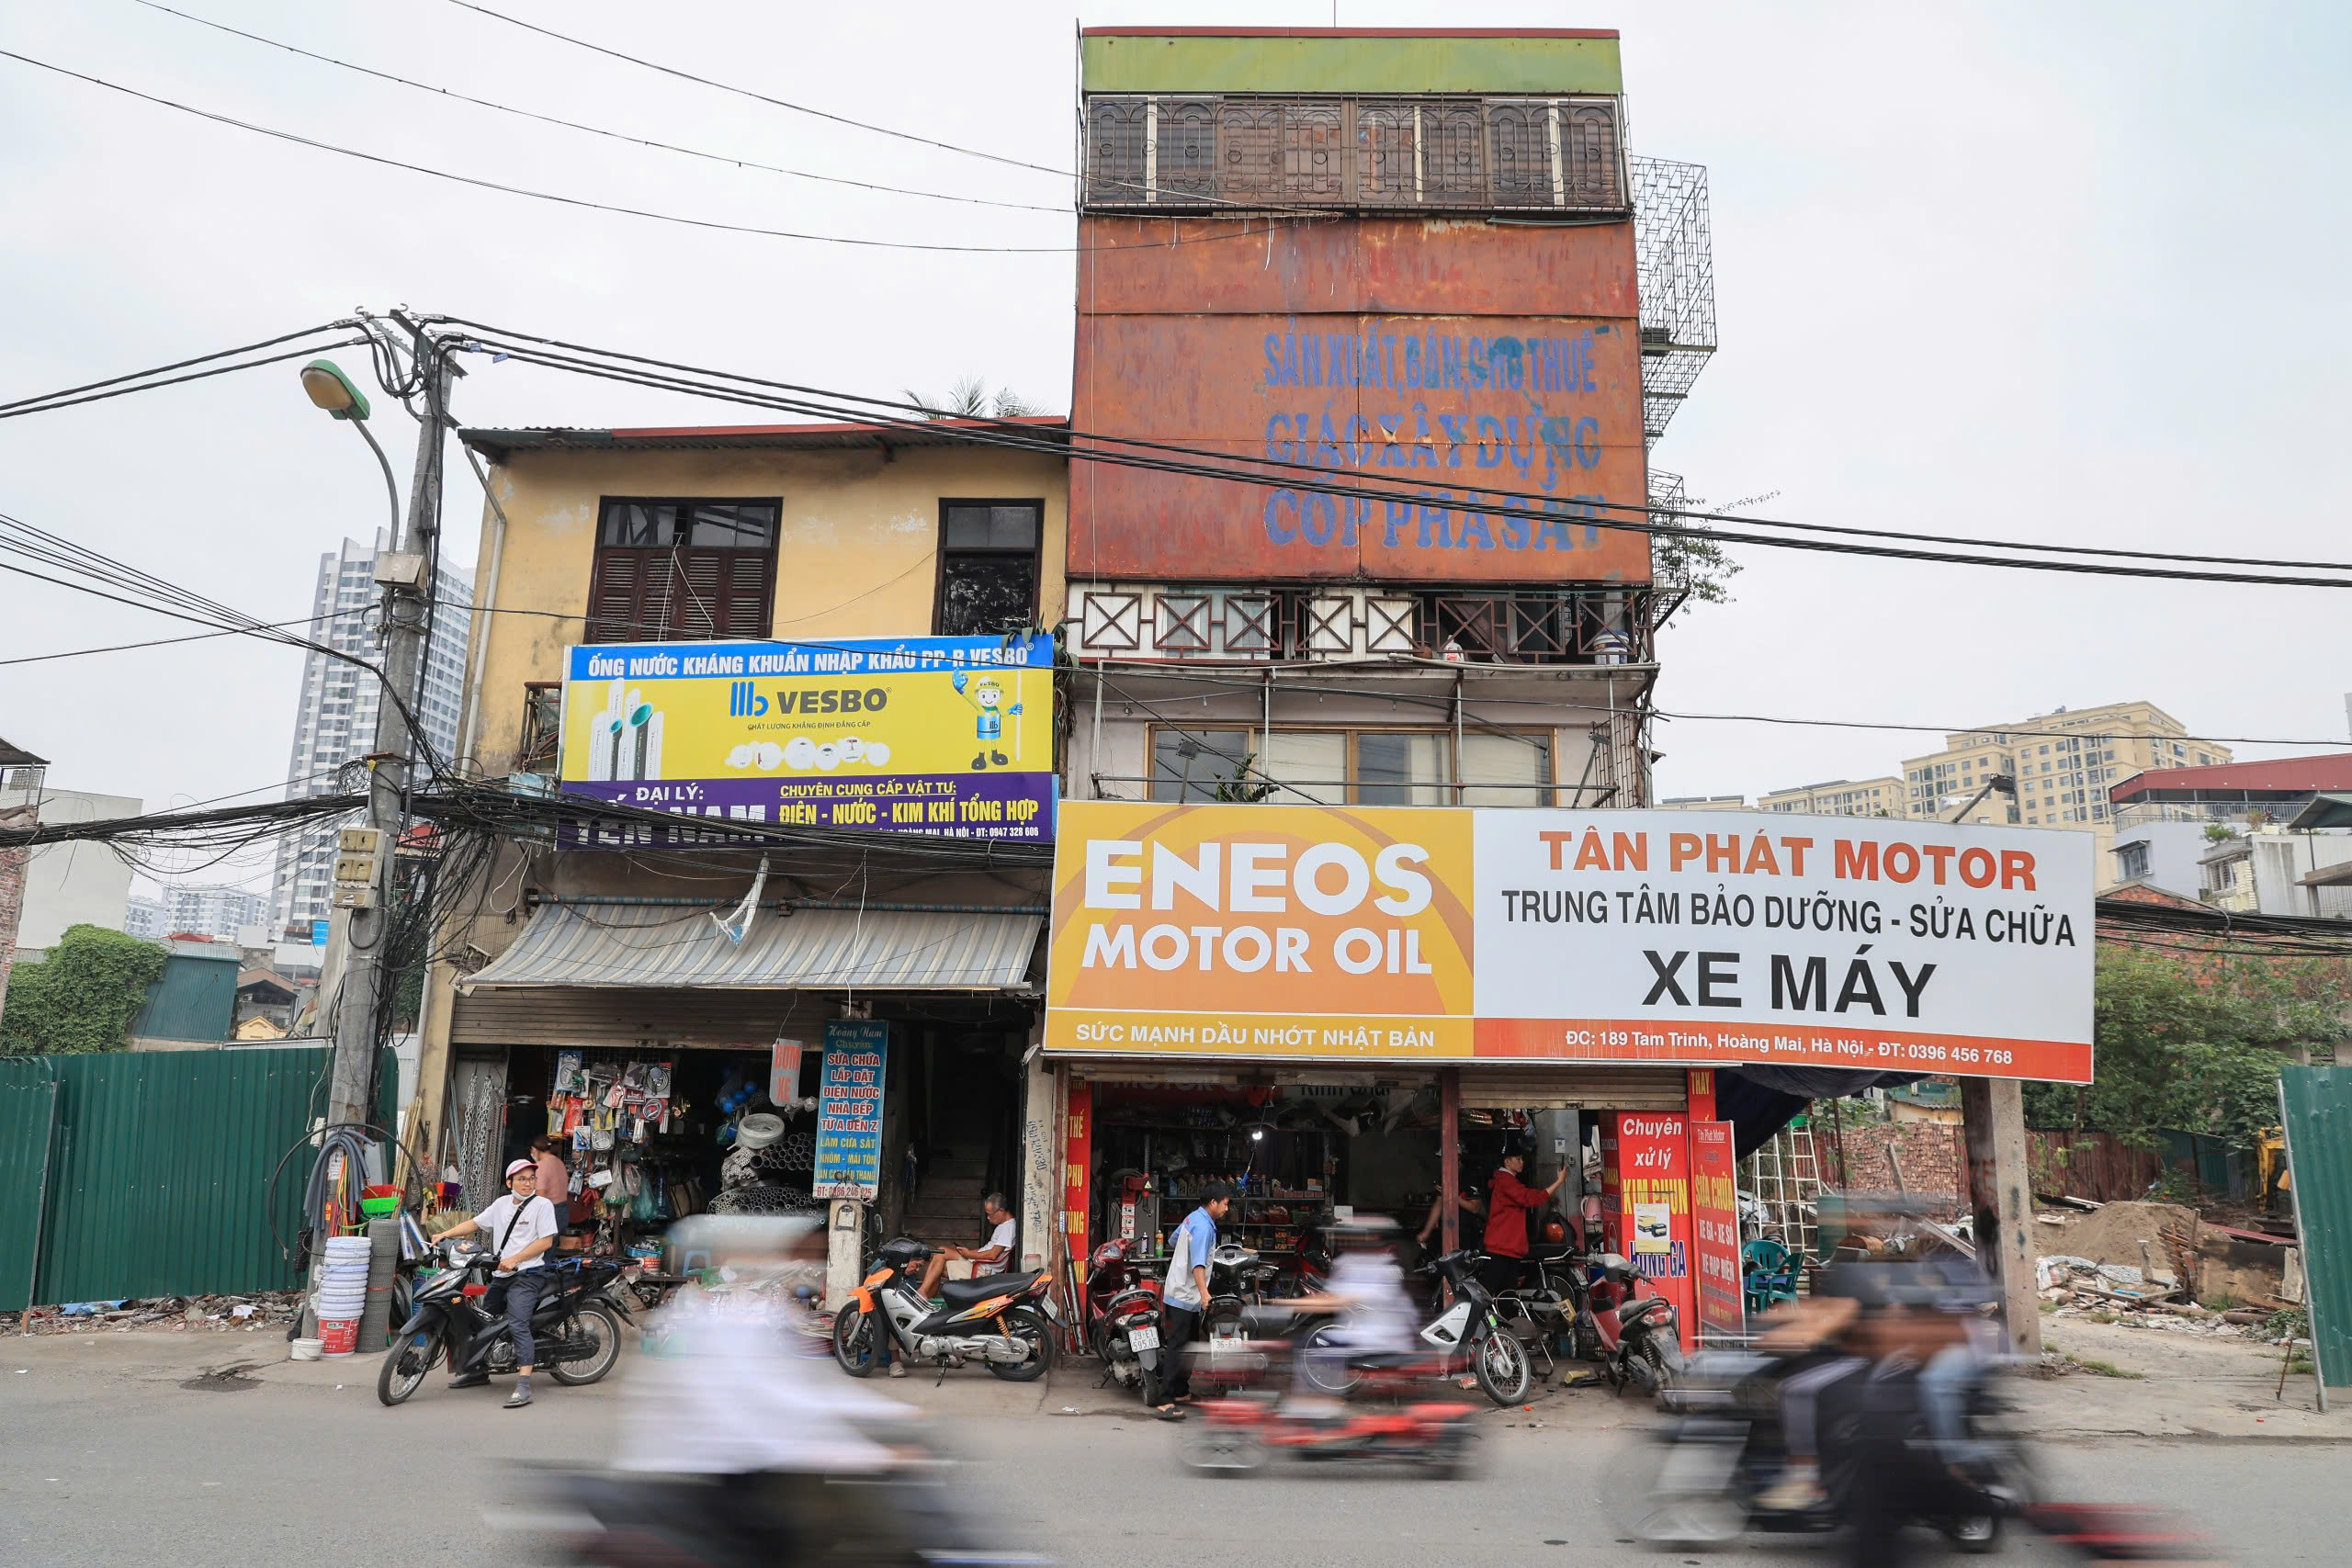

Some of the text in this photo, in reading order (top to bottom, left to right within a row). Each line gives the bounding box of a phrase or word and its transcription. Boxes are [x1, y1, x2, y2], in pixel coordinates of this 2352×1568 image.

[1526, 327, 1597, 393] THUÊ
[1382, 490, 1497, 550] PHA
[588, 652, 625, 677] ỐNG
[629, 652, 678, 676] NƯỚC
[683, 653, 744, 675] KHÁNG
[748, 647, 809, 673] KHUẨN
[814, 649, 863, 675] NHẬP
[868, 644, 916, 670] KHẨU
[921, 649, 965, 669] PP-R
[776, 687, 888, 715] VESBO
[636, 782, 704, 805] ĐẠI LÝ:
[780, 778, 956, 797] CHUYÊN CUNG CẤP VẬT TƯ:
[832, 797, 876, 824] NƯỚC
[892, 802, 923, 823] KIM
[928, 796, 956, 822] KHÍ
[959, 793, 1001, 821] TỔNG
[1006, 798, 1039, 826] HỢP
[944, 827, 955, 837] HÀ
[976, 828, 988, 837] ĐT:
[989, 827, 1007, 837] 0947
[1009, 827, 1023, 837] 328
[1024, 827, 1039, 837] 606
[1539, 825, 2037, 892] TÂN PHÁT MOTOR
[1084, 839, 1433, 917] ENEOS
[1501, 889, 1608, 924] TRUNG
[1615, 883, 1680, 925] TÂM
[1690, 883, 1755, 928] BẢO
[1765, 889, 1882, 934] DƯỠNG
[1909, 895, 1976, 941] SỬA
[1985, 904, 2075, 947] CHỮA
[1081, 923, 1432, 975] MOTOR OIL
[1641, 943, 1938, 1018] XE MÁY
[1075, 1021, 1434, 1051] SỨC MẠNH DẦU NHỚT NHẬT BẢN
[1566, 1031, 1596, 1046] ĐC:
[1600, 1031, 1628, 1046] 189
[1631, 1032, 1665, 1047] Tam
[1668, 1032, 1713, 1050] Trinh,
[1717, 1034, 1770, 1054] Hoàng
[1774, 1036, 1806, 1055] Mai,
[1811, 1037, 1833, 1054] Hà
[1837, 1038, 1864, 1057] Nội
[1878, 1043, 1905, 1058] ĐT:
[1908, 1043, 1948, 1060] 0396
[1951, 1046, 1979, 1063] 456
[1984, 1048, 2012, 1065] 768
[828, 1049, 881, 1066] SỬA CHỮA
[823, 1084, 880, 1100] ĐIỆN NƯỚC
[1690, 1071, 1710, 1095] THAY
[827, 1100, 875, 1116] NHÀ BẾP
[820, 1116, 837, 1131] TỪ
[836, 1119, 845, 1131] A
[870, 1120, 878, 1132] Z
[1069, 1109, 1084, 1138] THẾ
[1623, 1117, 1682, 1140] Chuyên
[820, 1135, 839, 1147] LÀM
[1634, 1145, 1672, 1170] xử lý
[1067, 1164, 1083, 1192] PHỤ
[1695, 1163, 1712, 1209] SỬA
[1623, 1178, 1649, 1215] KIM
[1651, 1178, 1689, 1215] PHUN
[1669, 1240, 1688, 1278] GA
